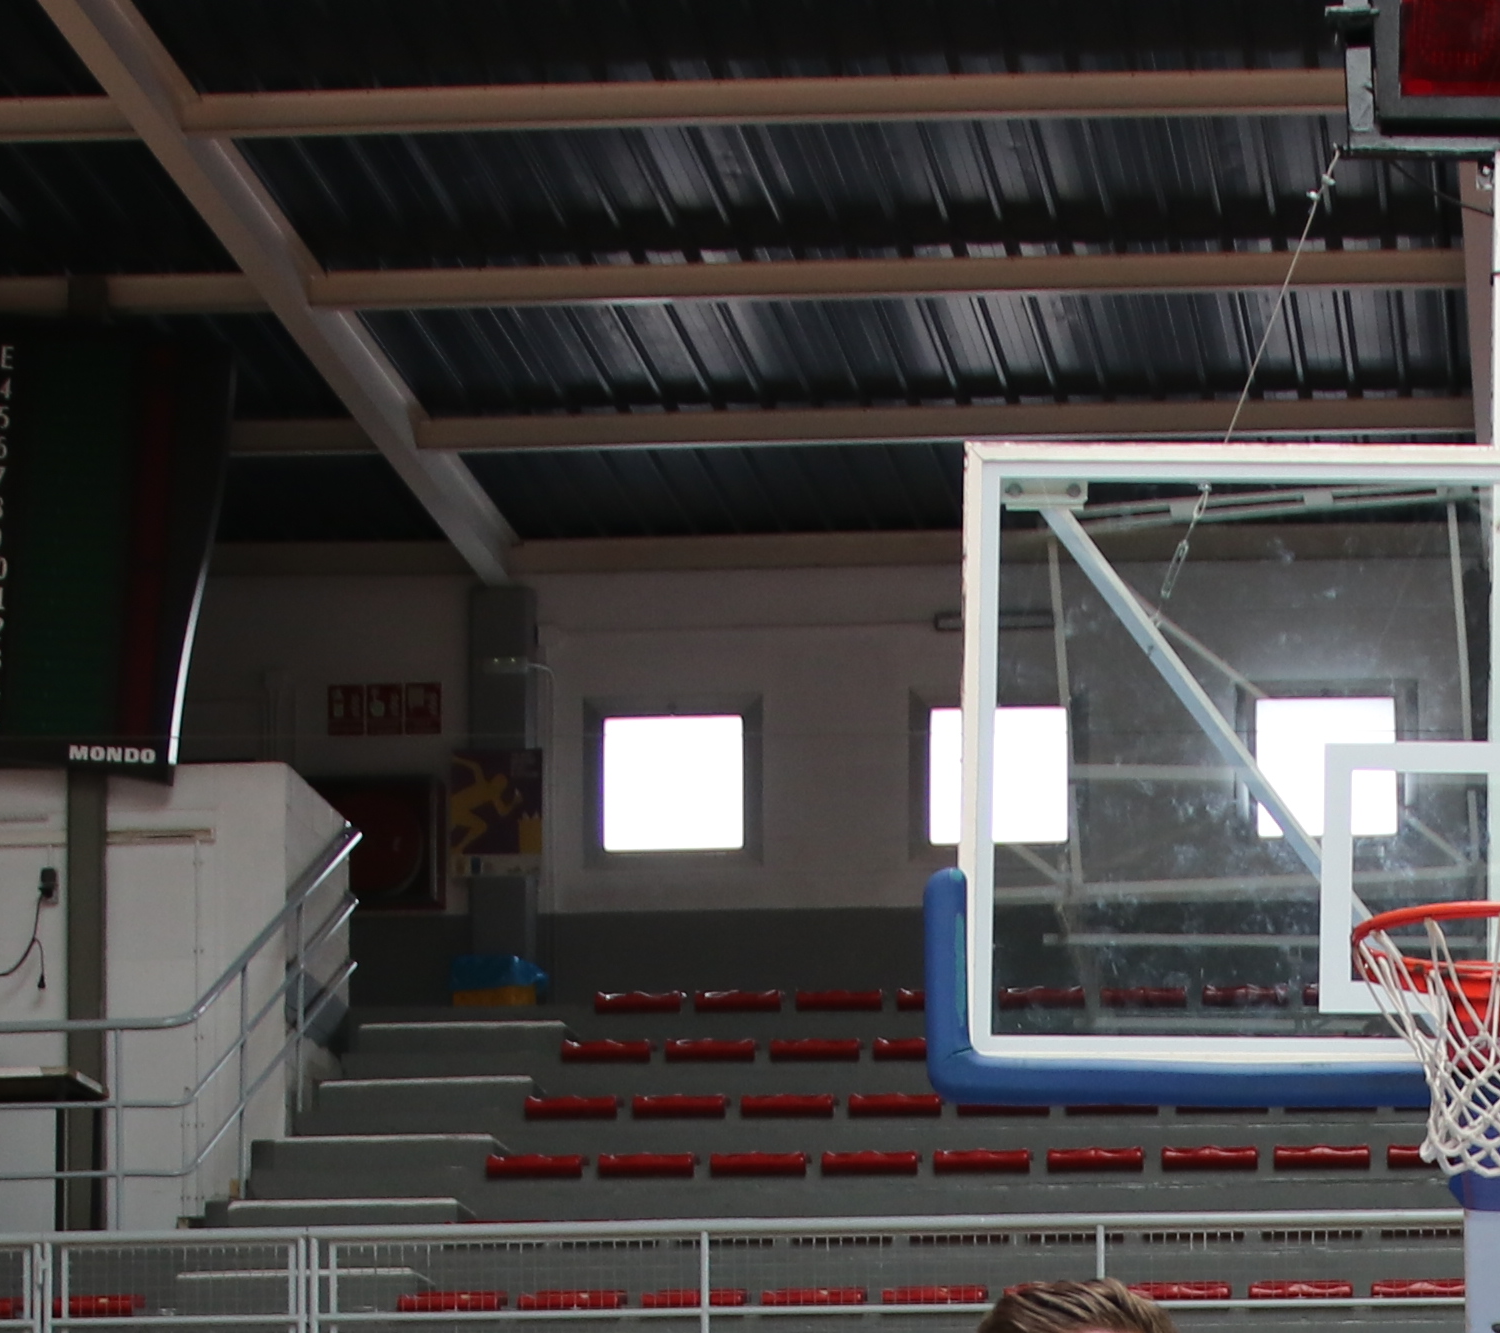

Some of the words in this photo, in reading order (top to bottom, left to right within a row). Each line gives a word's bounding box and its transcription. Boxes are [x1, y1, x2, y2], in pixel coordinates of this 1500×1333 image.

[0, 345, 14, 370] E
[0, 378, 12, 399] 4
[68, 745, 156, 764] MONDO
